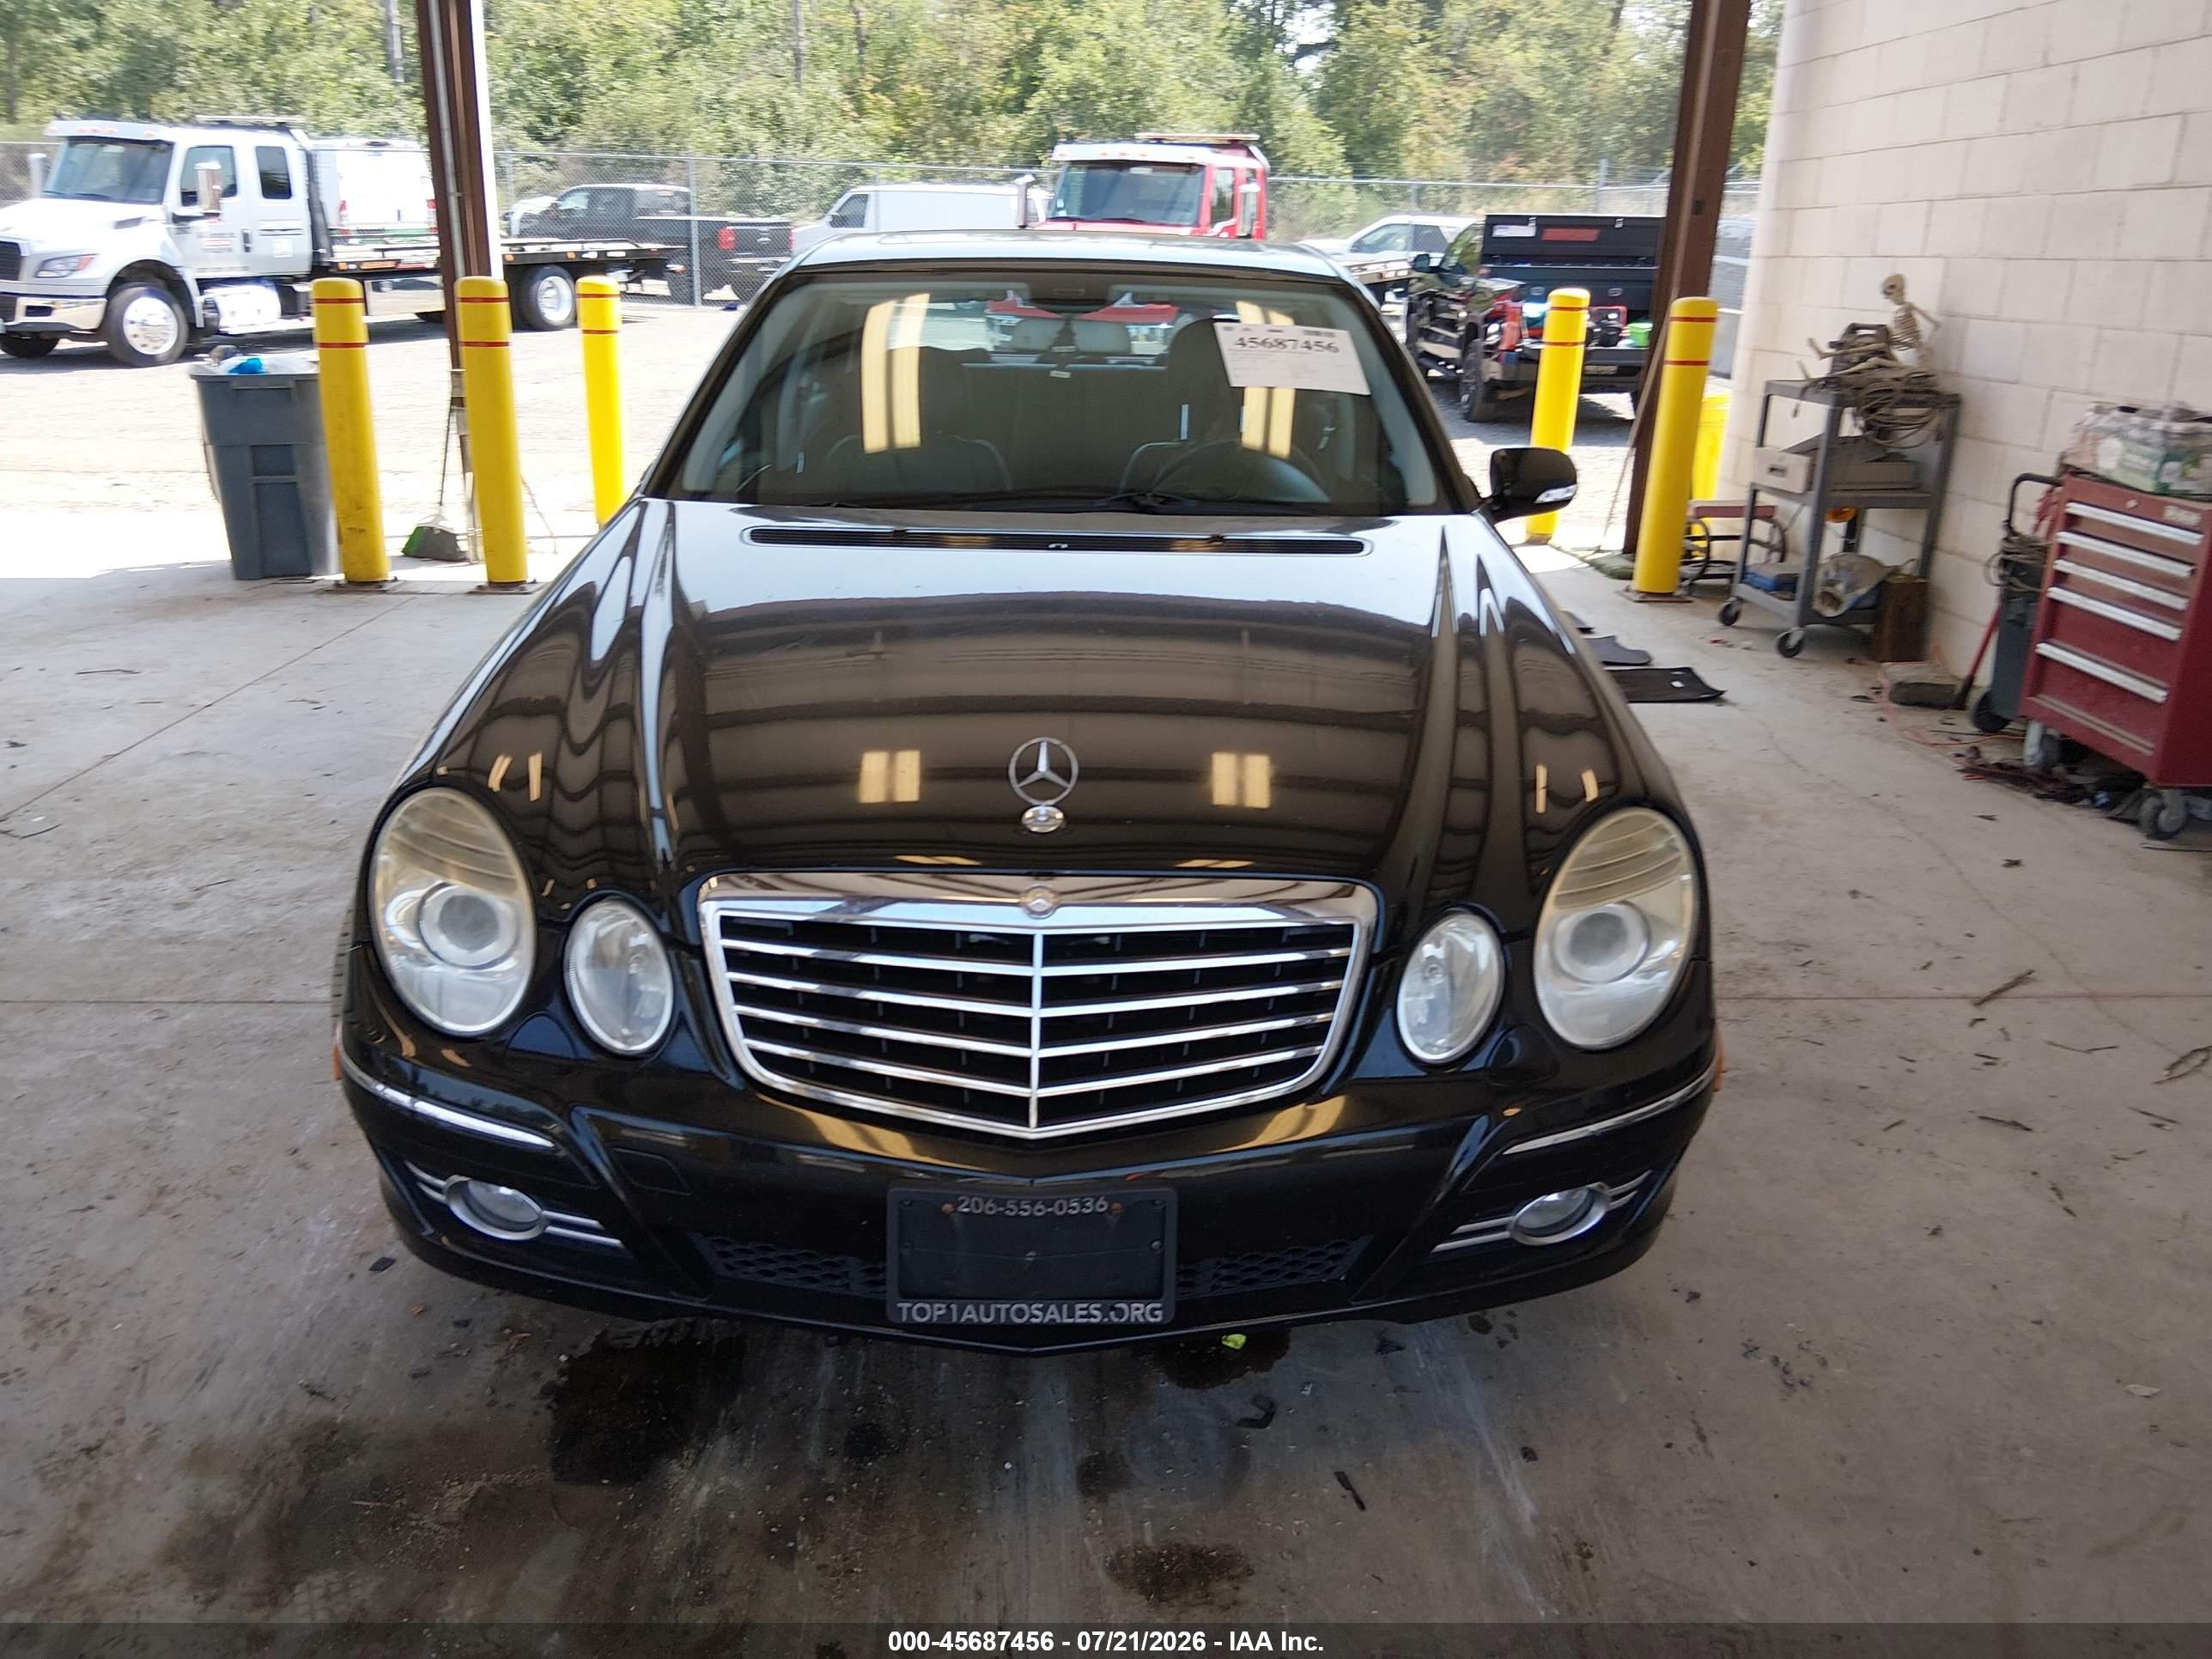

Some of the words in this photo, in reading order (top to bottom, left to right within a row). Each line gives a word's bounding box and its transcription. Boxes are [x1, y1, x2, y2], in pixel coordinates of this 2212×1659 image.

[1236, 337, 1340, 353] 45687456
[956, 1195, 1109, 1217] 206-556-0536
[896, 1302, 1164, 1324] TOP1AUTOSALES.ORG
